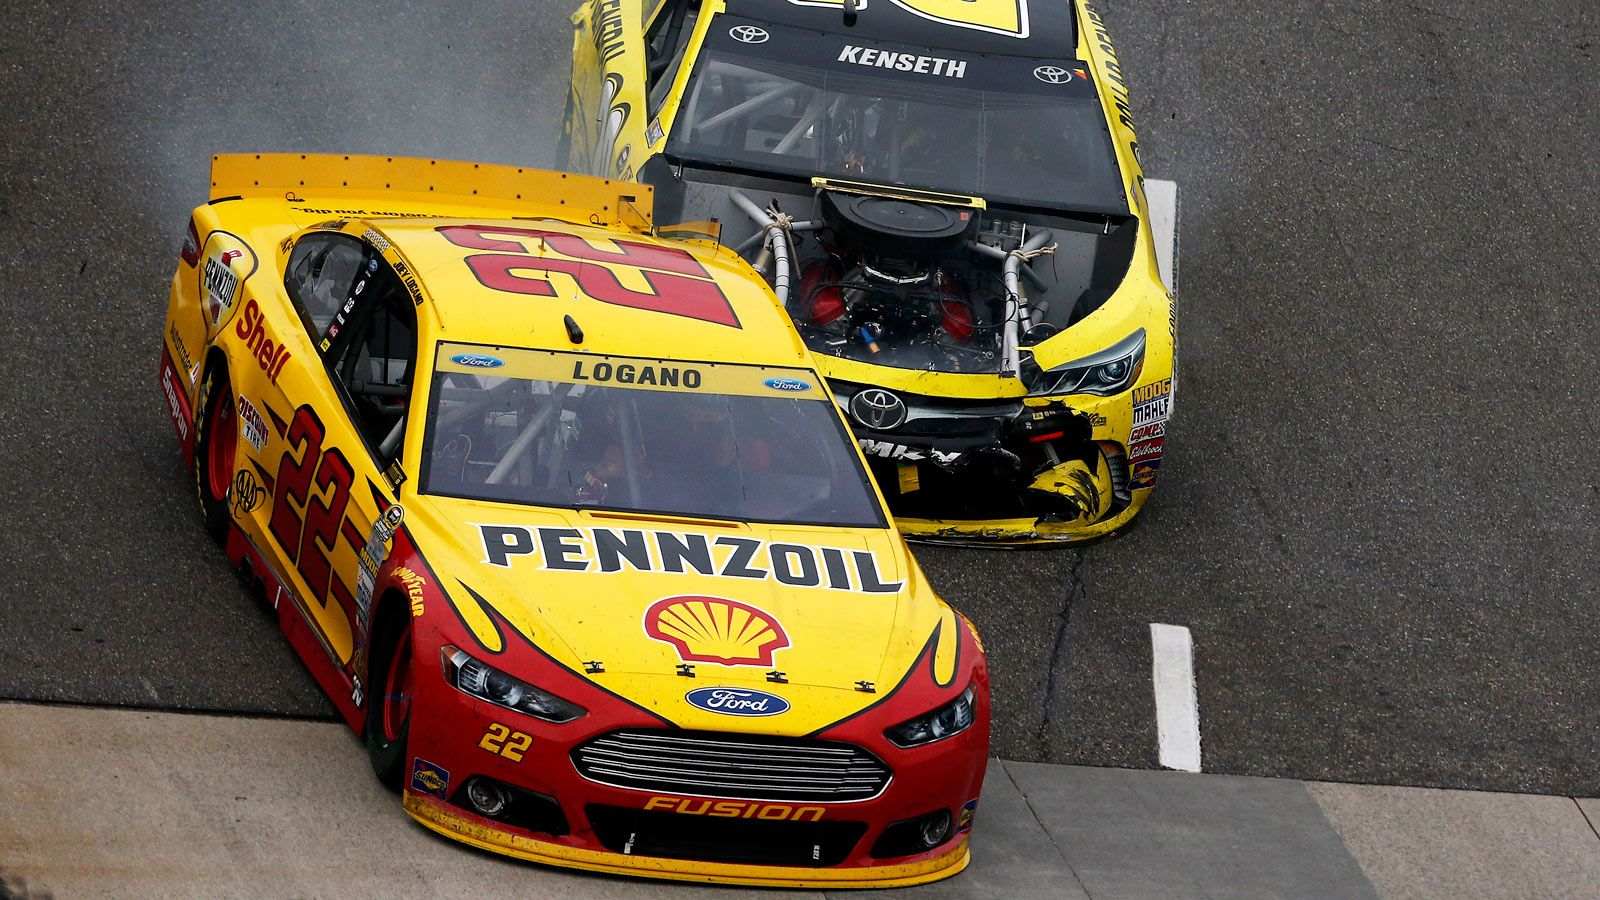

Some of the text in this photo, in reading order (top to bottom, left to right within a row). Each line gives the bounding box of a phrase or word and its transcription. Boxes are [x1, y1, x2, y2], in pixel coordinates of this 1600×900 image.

[837, 44, 967, 78] KENSETH
[205, 256, 239, 309] PENNZOIL
[393, 261, 424, 306] JOEY LOGANO
[434, 225, 743, 329] 22
[236, 299, 292, 387] Shell
[457, 355, 496, 368] Ford
[573, 360, 702, 389] LOGANO
[771, 378, 804, 391] Ford
[1134, 378, 1171, 404] MOOG
[162, 366, 188, 440] Snap-on
[239, 395, 269, 447] DISCOUNT
[245, 424, 261, 449] TIRE
[1130, 423, 1160, 441] COMP
[268, 403, 355, 609] 22
[359, 546, 380, 578] MOOG
[478, 524, 905, 594] PENNZOIL
[703, 689, 770, 716] Ford
[478, 721, 534, 764] 22
[414, 771, 447, 790] SUNOCO
[643, 795, 827, 823] FUSION
